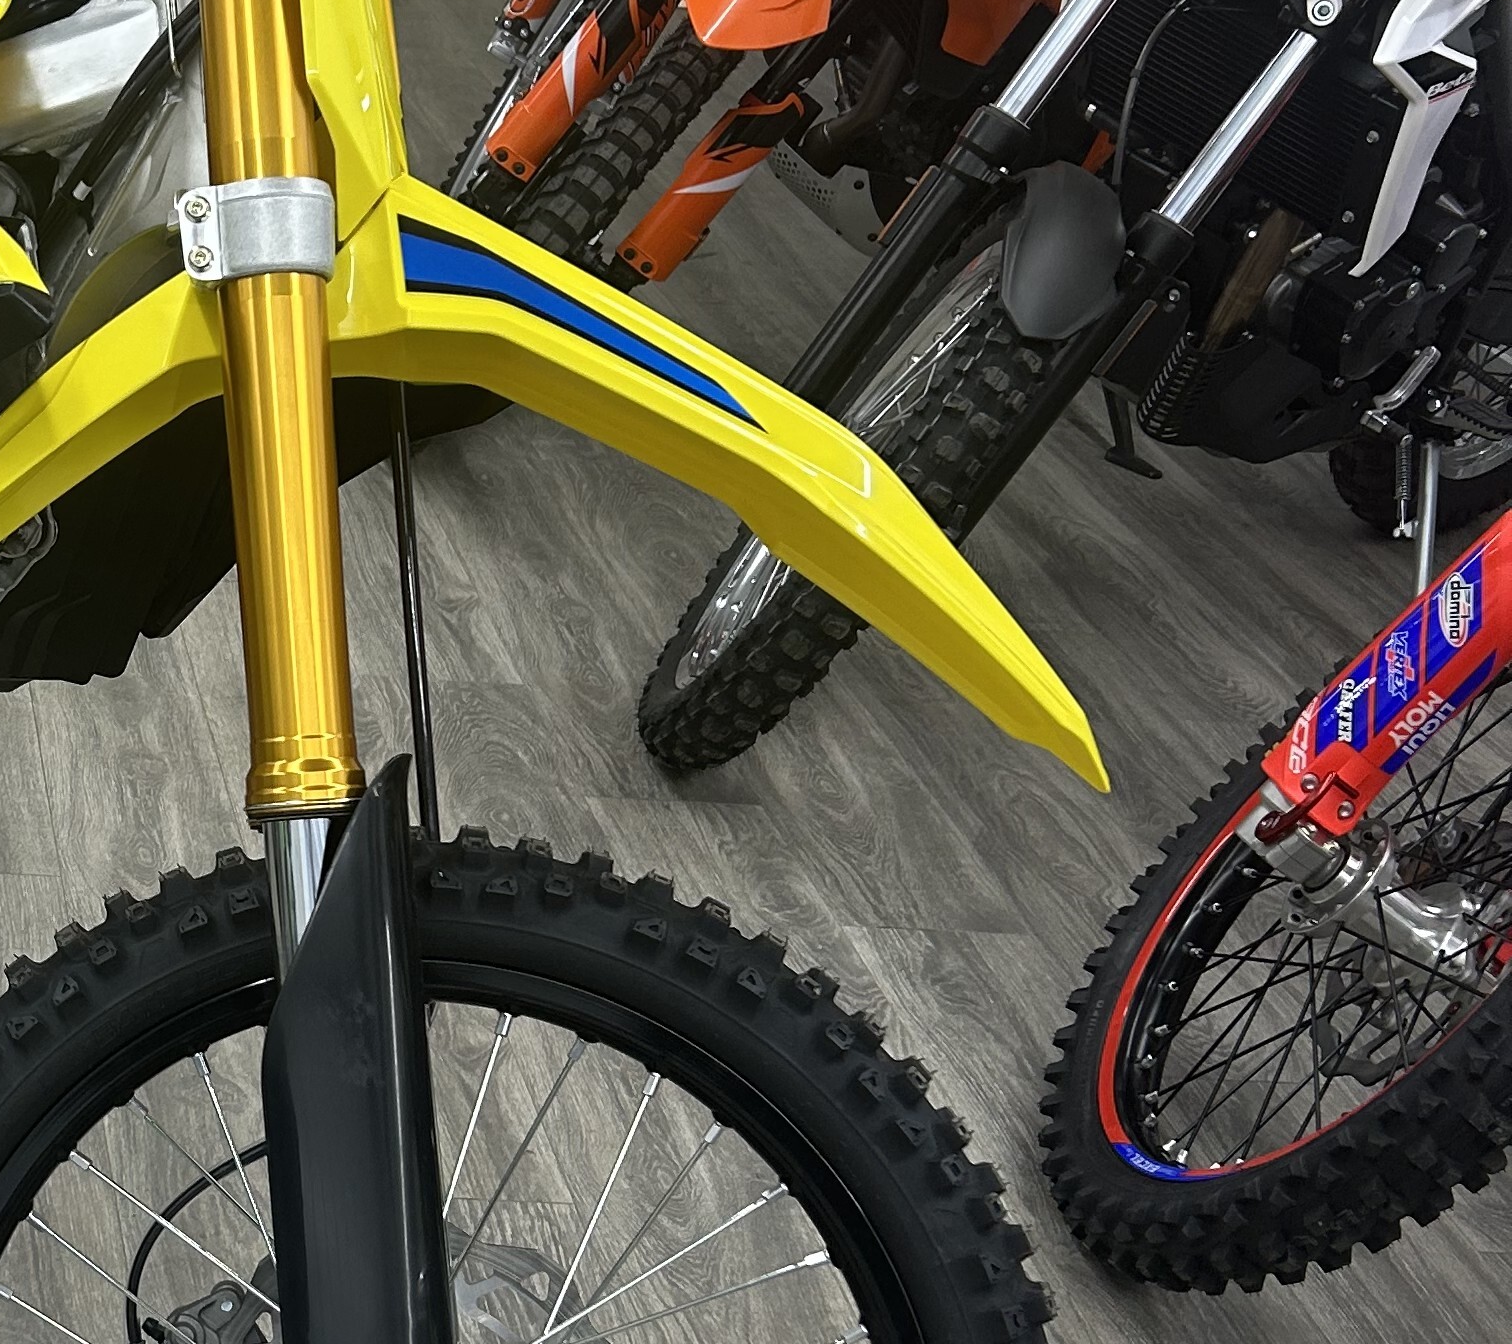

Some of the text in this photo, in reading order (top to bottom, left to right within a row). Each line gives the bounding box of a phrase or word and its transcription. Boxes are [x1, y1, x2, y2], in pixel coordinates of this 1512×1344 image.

[1448, 580, 1472, 640] domino
[1391, 630, 1409, 701] VERTEX
[1337, 678, 1356, 743] GALFER
[1388, 690, 1445, 749] MOLY
[1405, 701, 1457, 756] LIQUI
